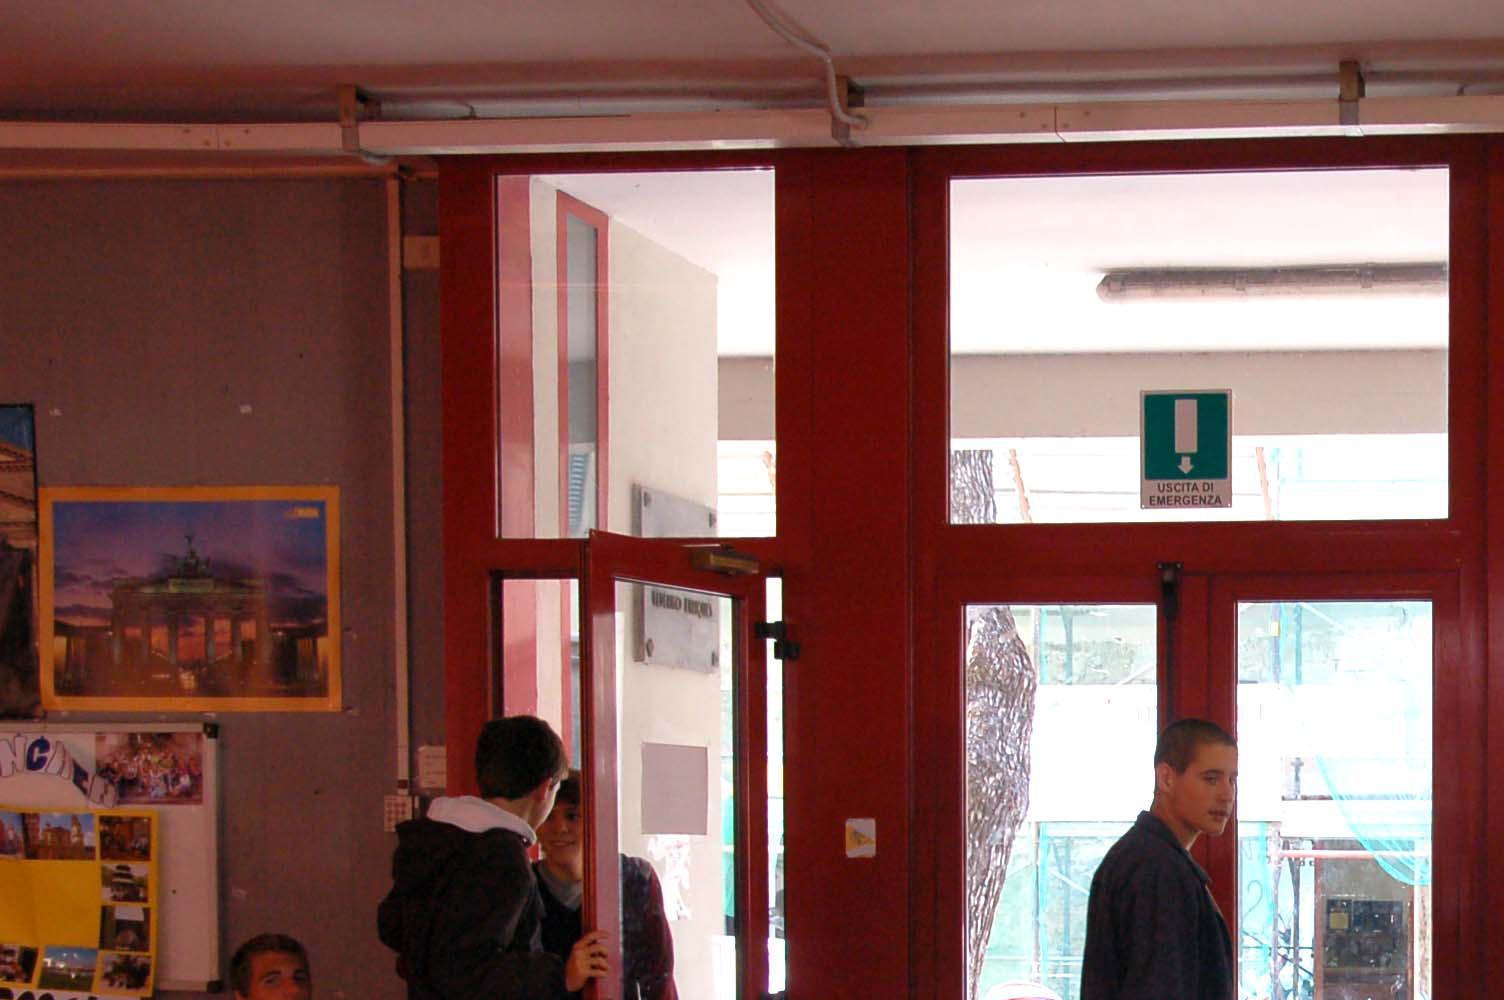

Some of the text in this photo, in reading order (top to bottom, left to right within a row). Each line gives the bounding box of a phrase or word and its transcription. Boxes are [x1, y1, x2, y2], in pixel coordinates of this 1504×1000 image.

[1157, 482, 1214, 493] USCITA DI
[1148, 495, 1222, 506] EMERGENZA
